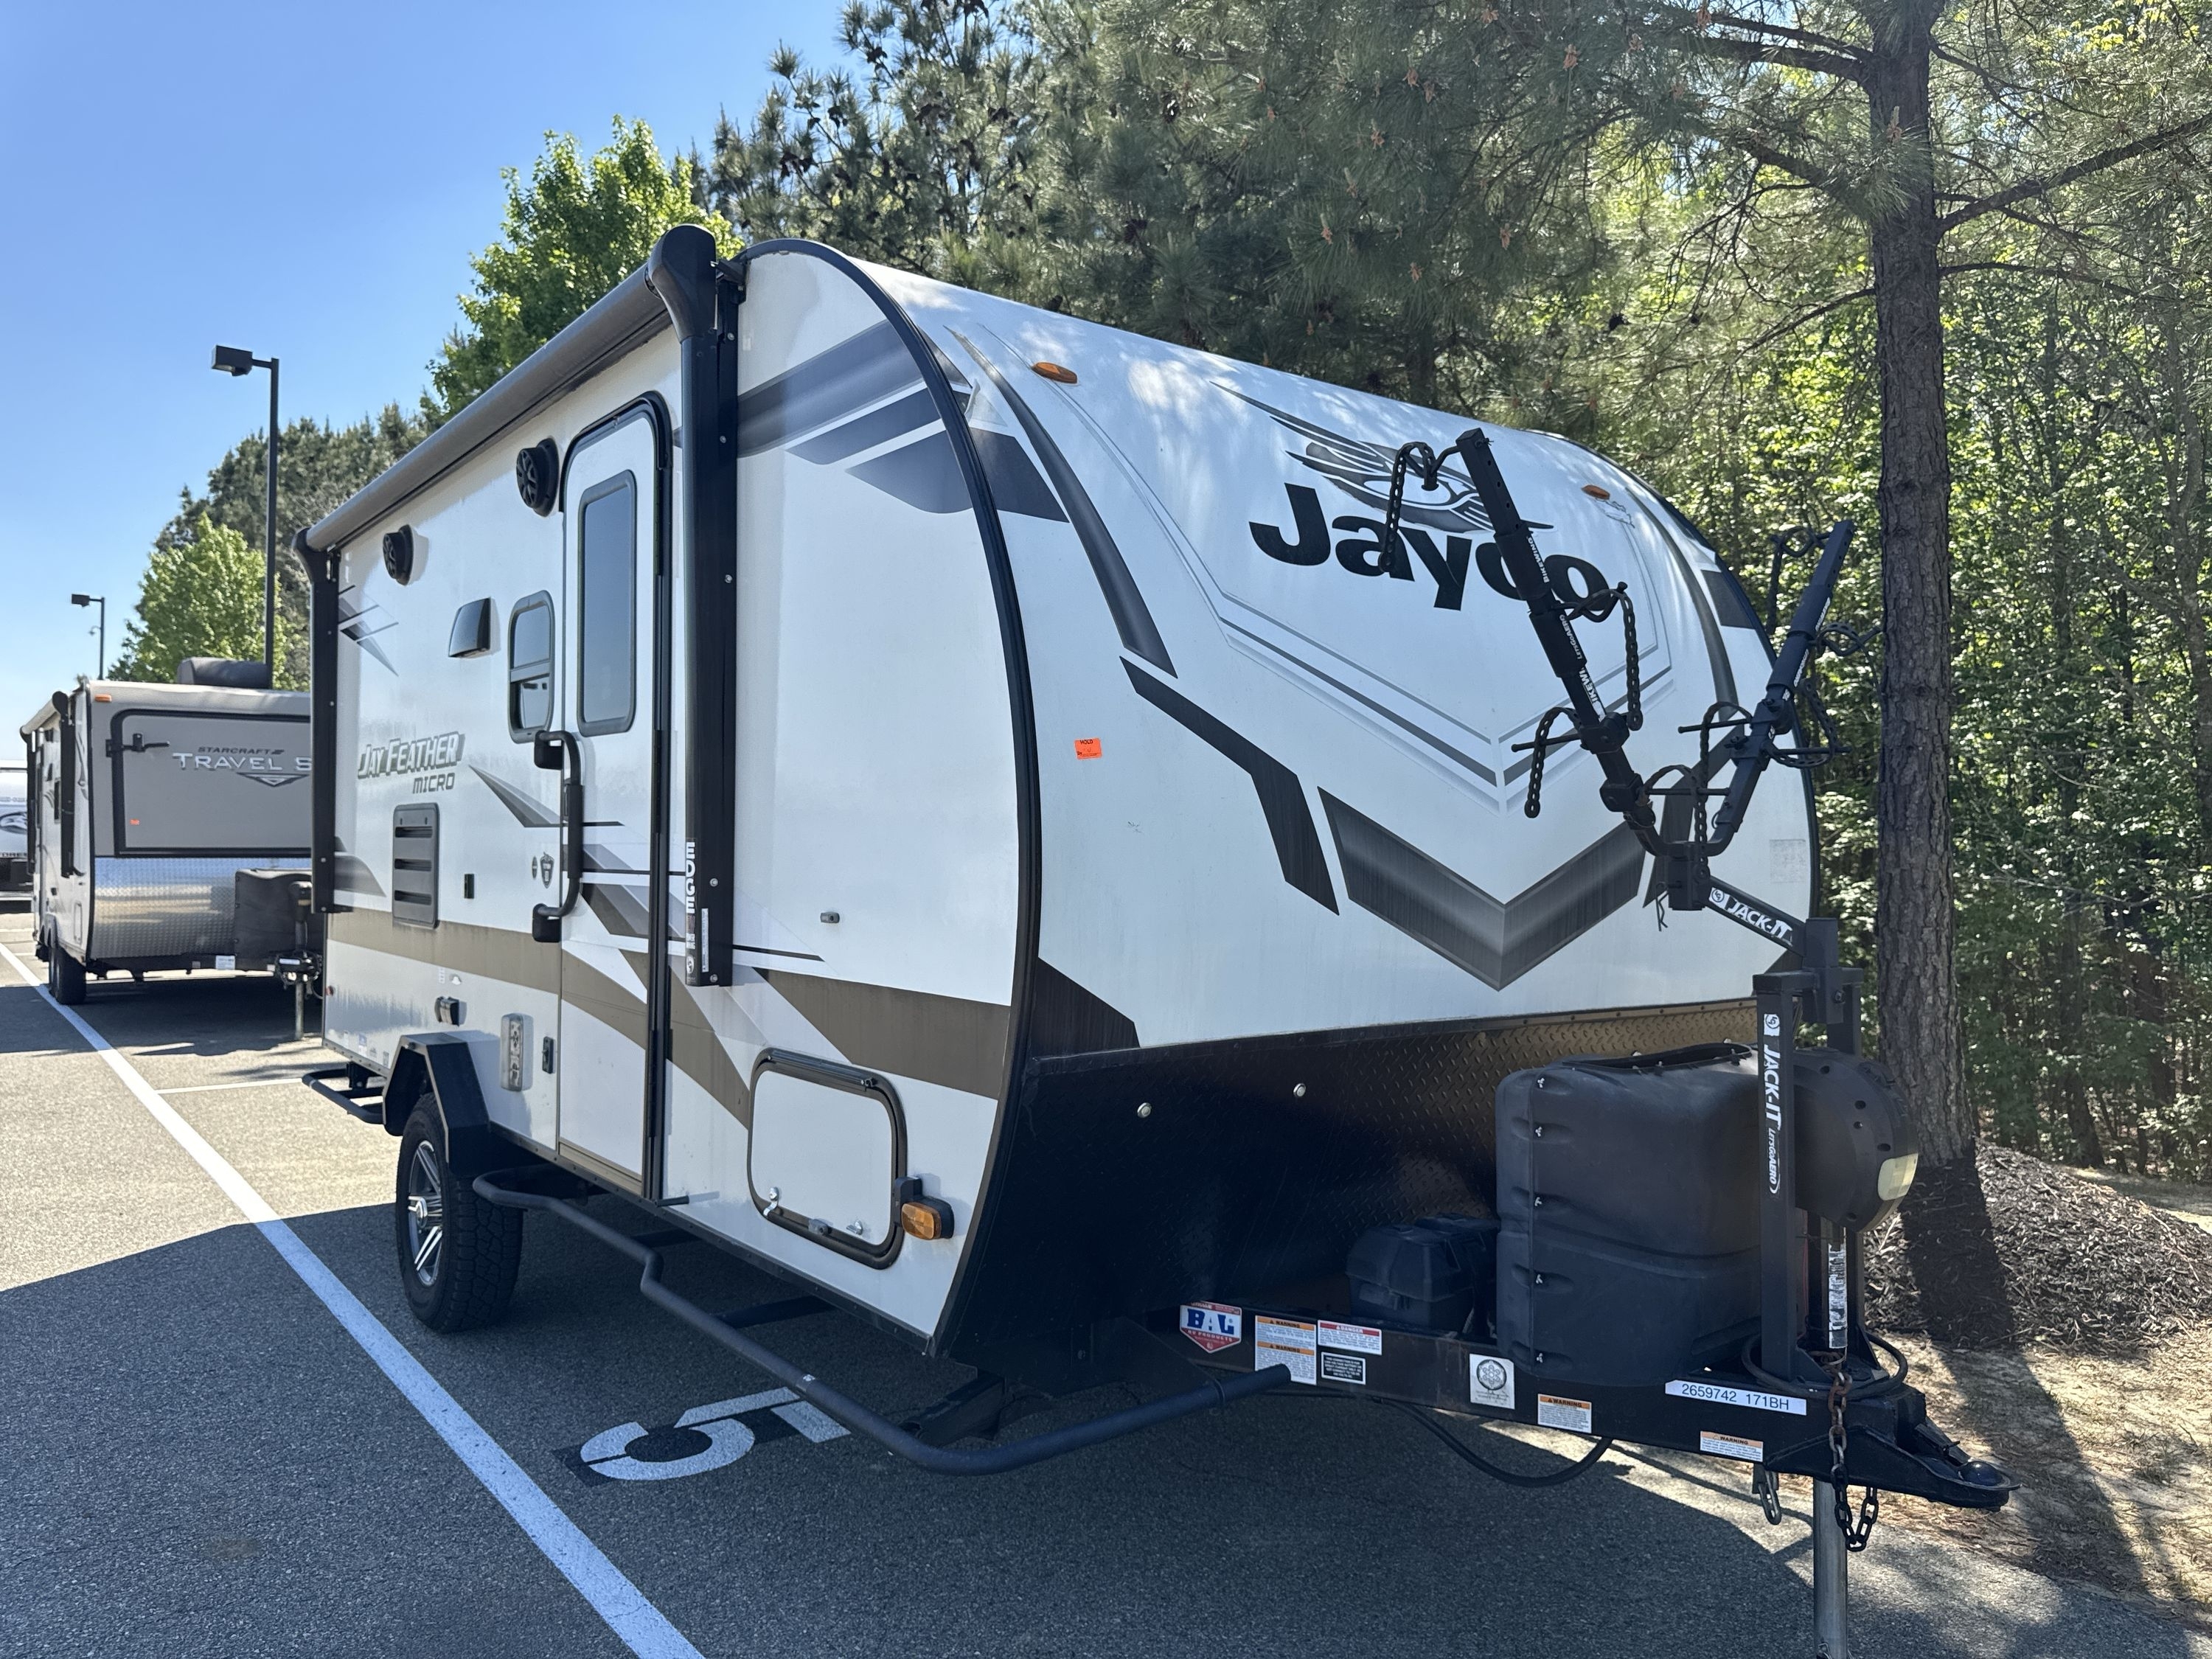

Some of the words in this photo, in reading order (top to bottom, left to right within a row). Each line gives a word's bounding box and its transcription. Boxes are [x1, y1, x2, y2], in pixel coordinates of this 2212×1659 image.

[173, 753, 283, 771] TRAVEL
[198, 746, 271, 755] STARCRAFT
[358, 744, 386, 779] JAY
[386, 731, 463, 775] FEATHER
[412, 773, 456, 794] MICRO
[686, 841, 696, 914] EDGE
[1728, 899, 1792, 939] JACK-IT
[1764, 1043, 1781, 1130] JACK-IT
[1187, 1308, 1234, 1335] BAL
[1554, 1398, 1583, 1408] WARNING
[1682, 1383, 1737, 1402] 2659742
[1745, 1394, 1790, 1411] 171BH
[1719, 1436, 1749, 1445] WARNING
